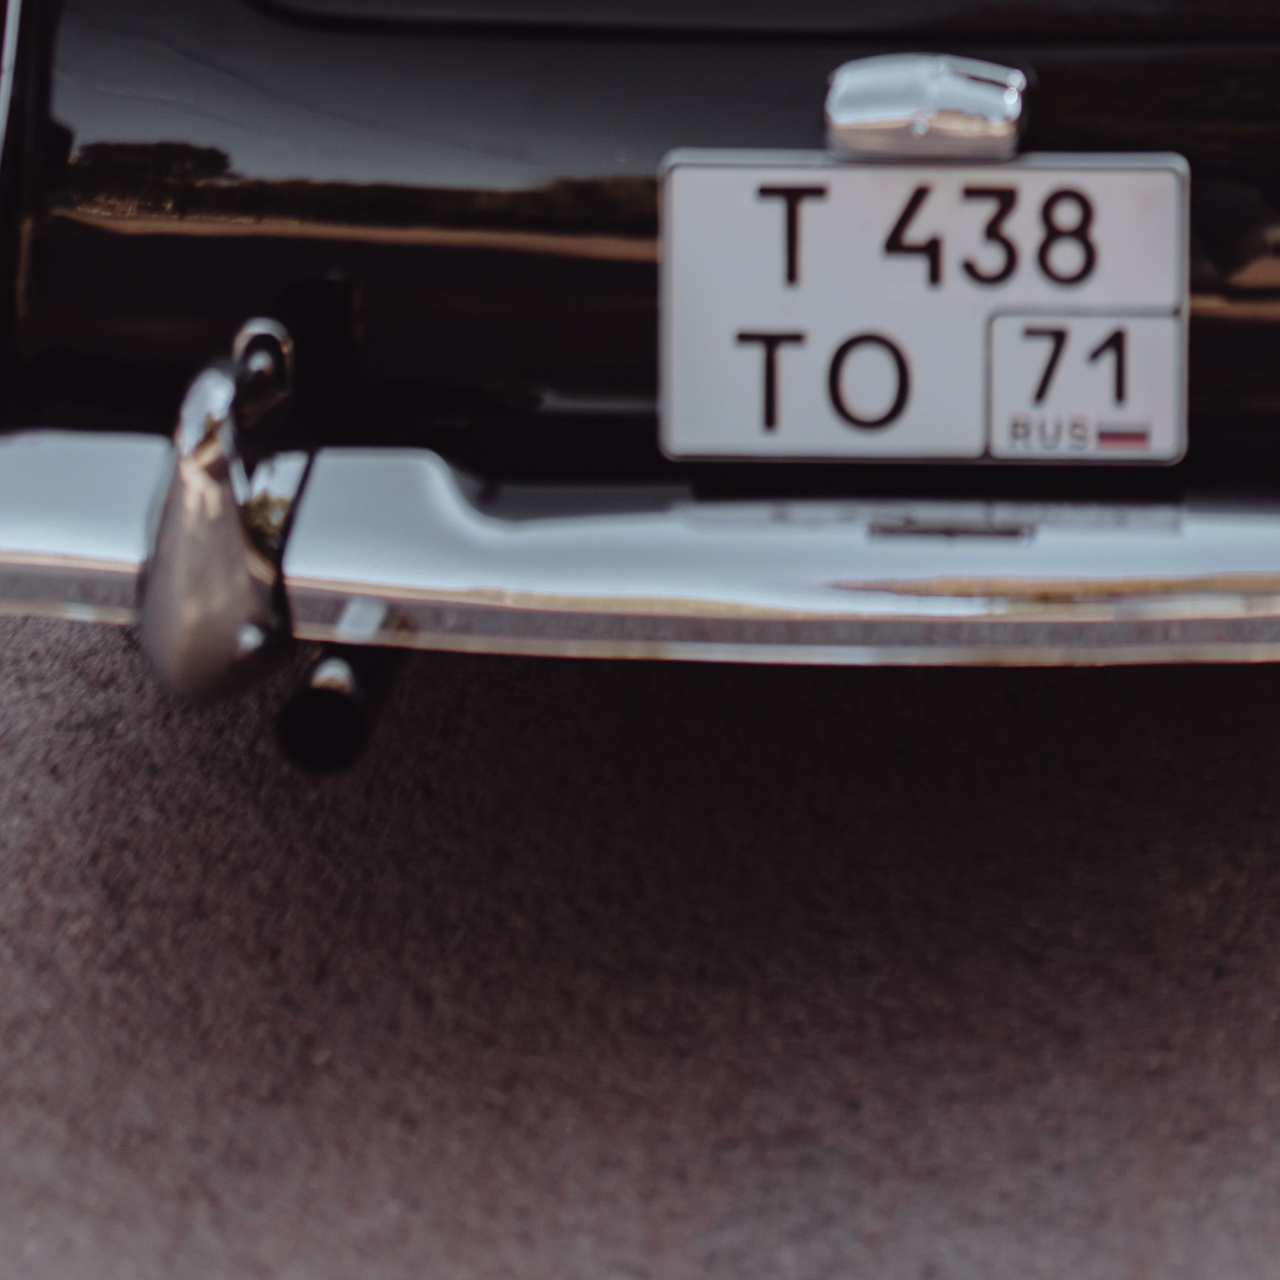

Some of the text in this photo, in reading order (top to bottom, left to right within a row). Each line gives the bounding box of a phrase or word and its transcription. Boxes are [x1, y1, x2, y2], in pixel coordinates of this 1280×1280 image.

[881, 183, 1099, 289] 438
[1022, 326, 1128, 407] 71
[1009, 417, 1089, 450] RUS
